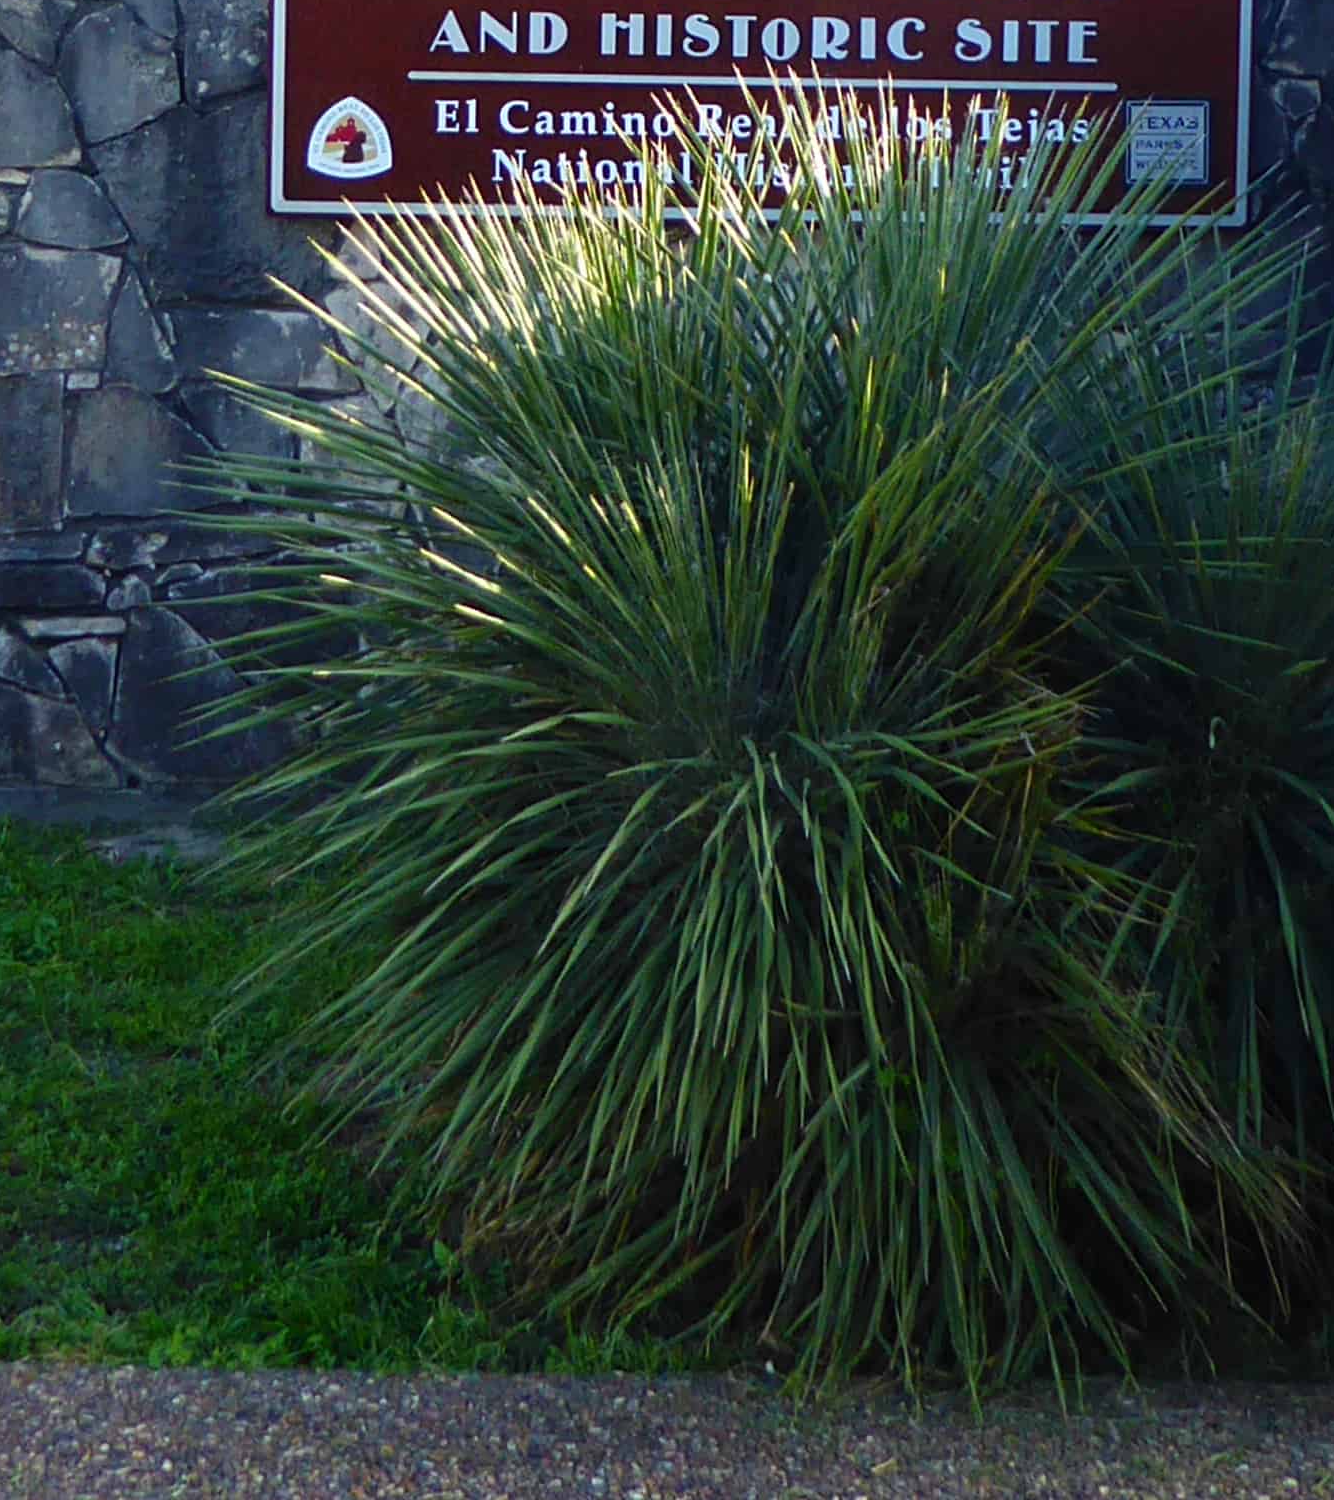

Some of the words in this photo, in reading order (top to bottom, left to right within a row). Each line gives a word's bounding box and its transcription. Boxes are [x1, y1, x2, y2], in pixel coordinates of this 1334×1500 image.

[429, 9, 569, 55] AND
[601, 12, 927, 61] HISTORIC
[955, 18, 1098, 64] SITE
[434, 98, 480, 134] El
[498, 100, 676, 136] Camino
[972, 107, 1090, 150] Tejas
